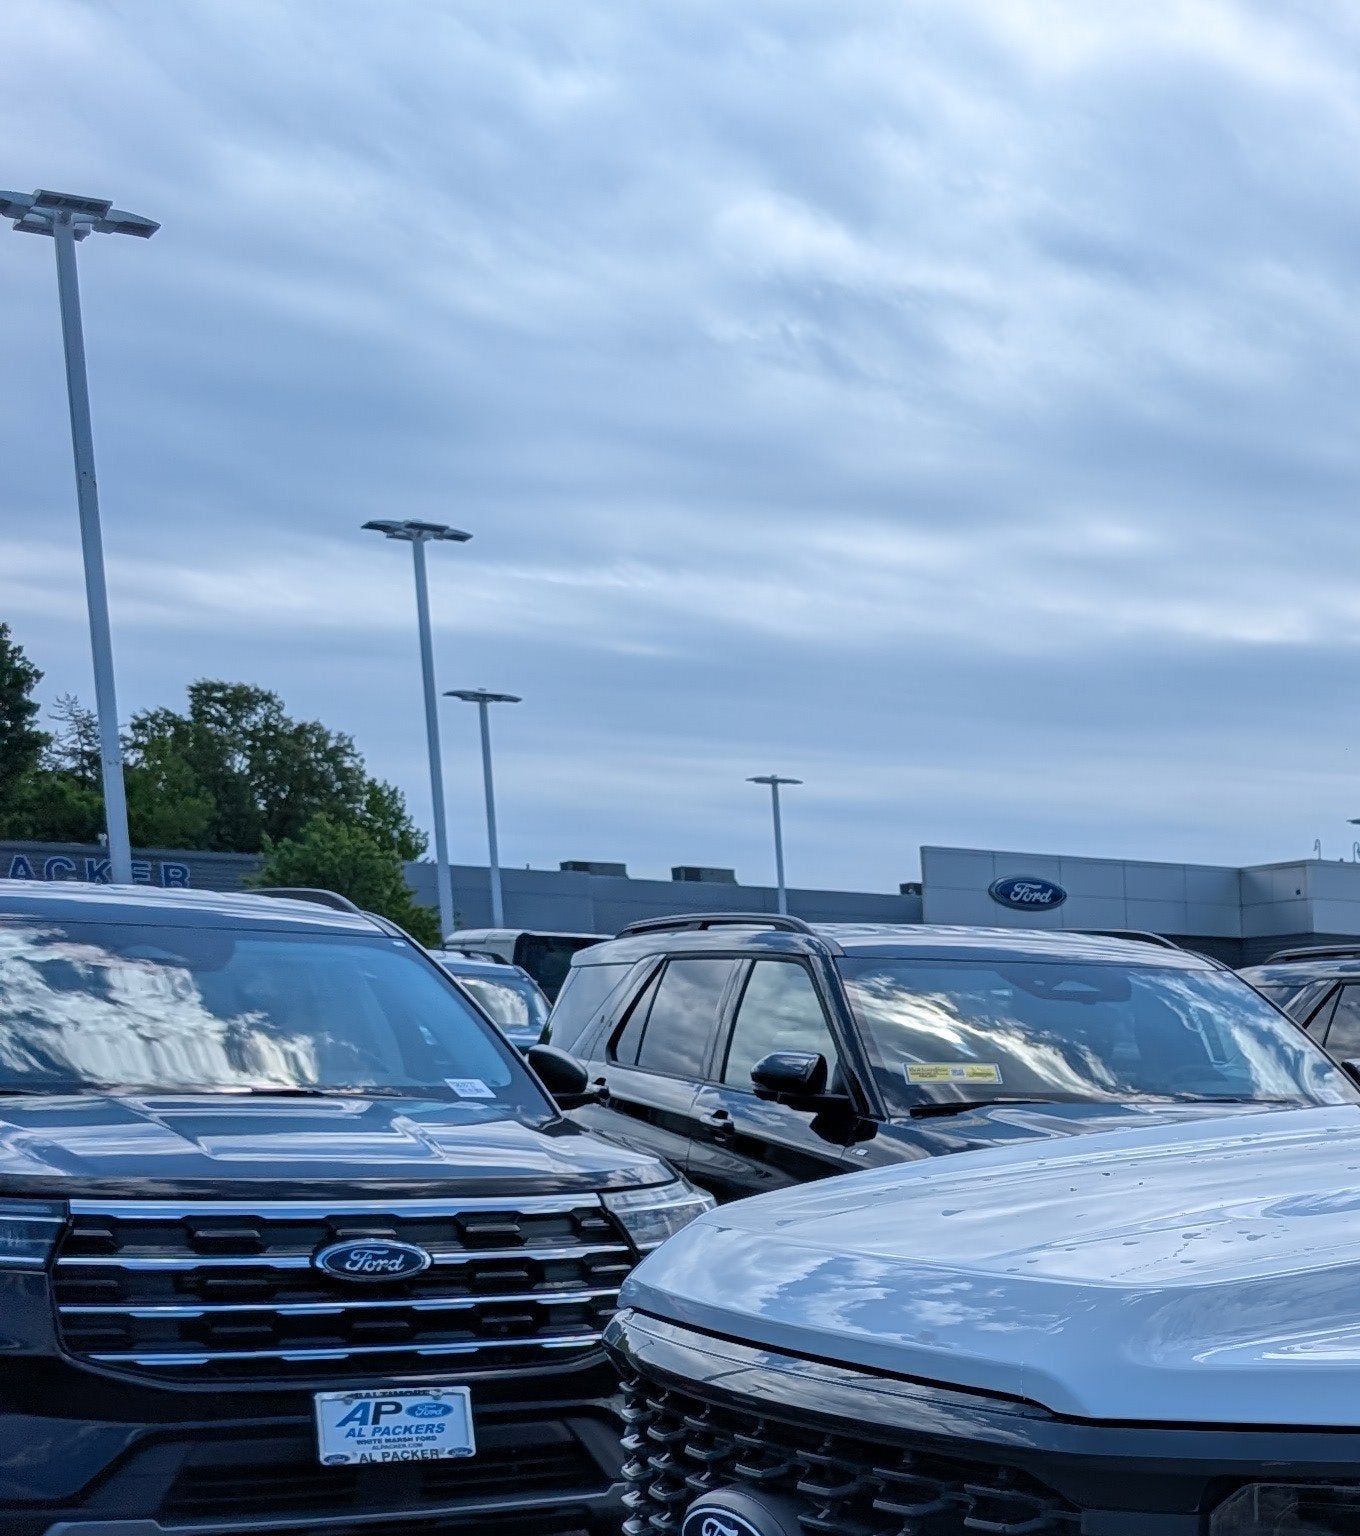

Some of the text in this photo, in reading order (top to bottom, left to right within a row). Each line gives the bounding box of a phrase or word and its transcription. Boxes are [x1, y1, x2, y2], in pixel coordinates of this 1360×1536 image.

[1010, 882, 1053, 903] Ford
[345, 1249, 405, 1272] Ford
[335, 1401, 403, 1428] AP
[414, 1404, 444, 1416] Ford
[345, 1423, 446, 1439] AL PACKERS
[356, 1438, 383, 1446] WHITE
[384, 1436, 414, 1444] MARSH
[359, 1453, 378, 1464] AL
[381, 1448, 440, 1462] PACKER
